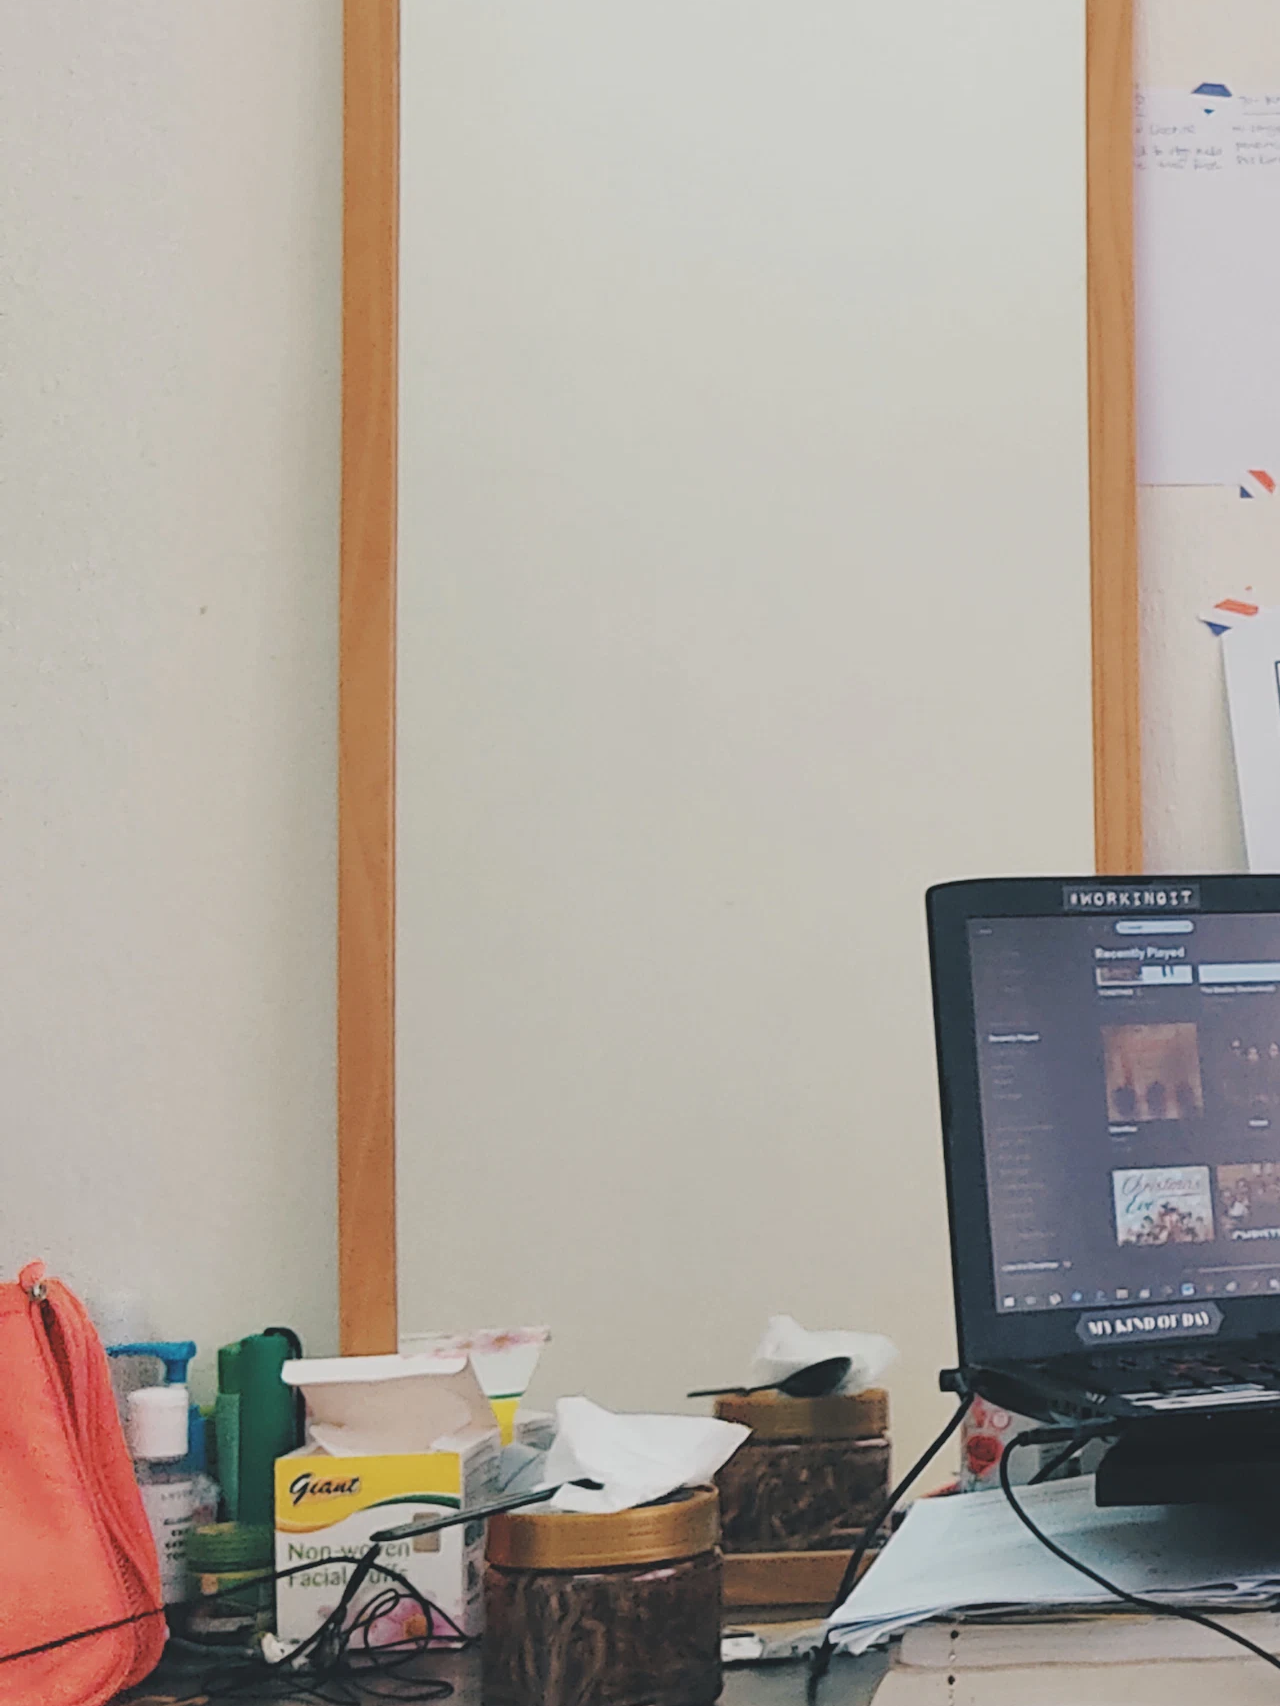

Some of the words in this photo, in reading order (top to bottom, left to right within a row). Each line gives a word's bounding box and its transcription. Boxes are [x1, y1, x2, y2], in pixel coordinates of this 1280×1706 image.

[1095, 947, 1145, 961] Recently
[1147, 946, 1185, 960] Played
[1115, 1316, 1155, 1333] KIND
[1157, 1314, 1177, 1329] OF
[289, 1472, 360, 1506] Giant
